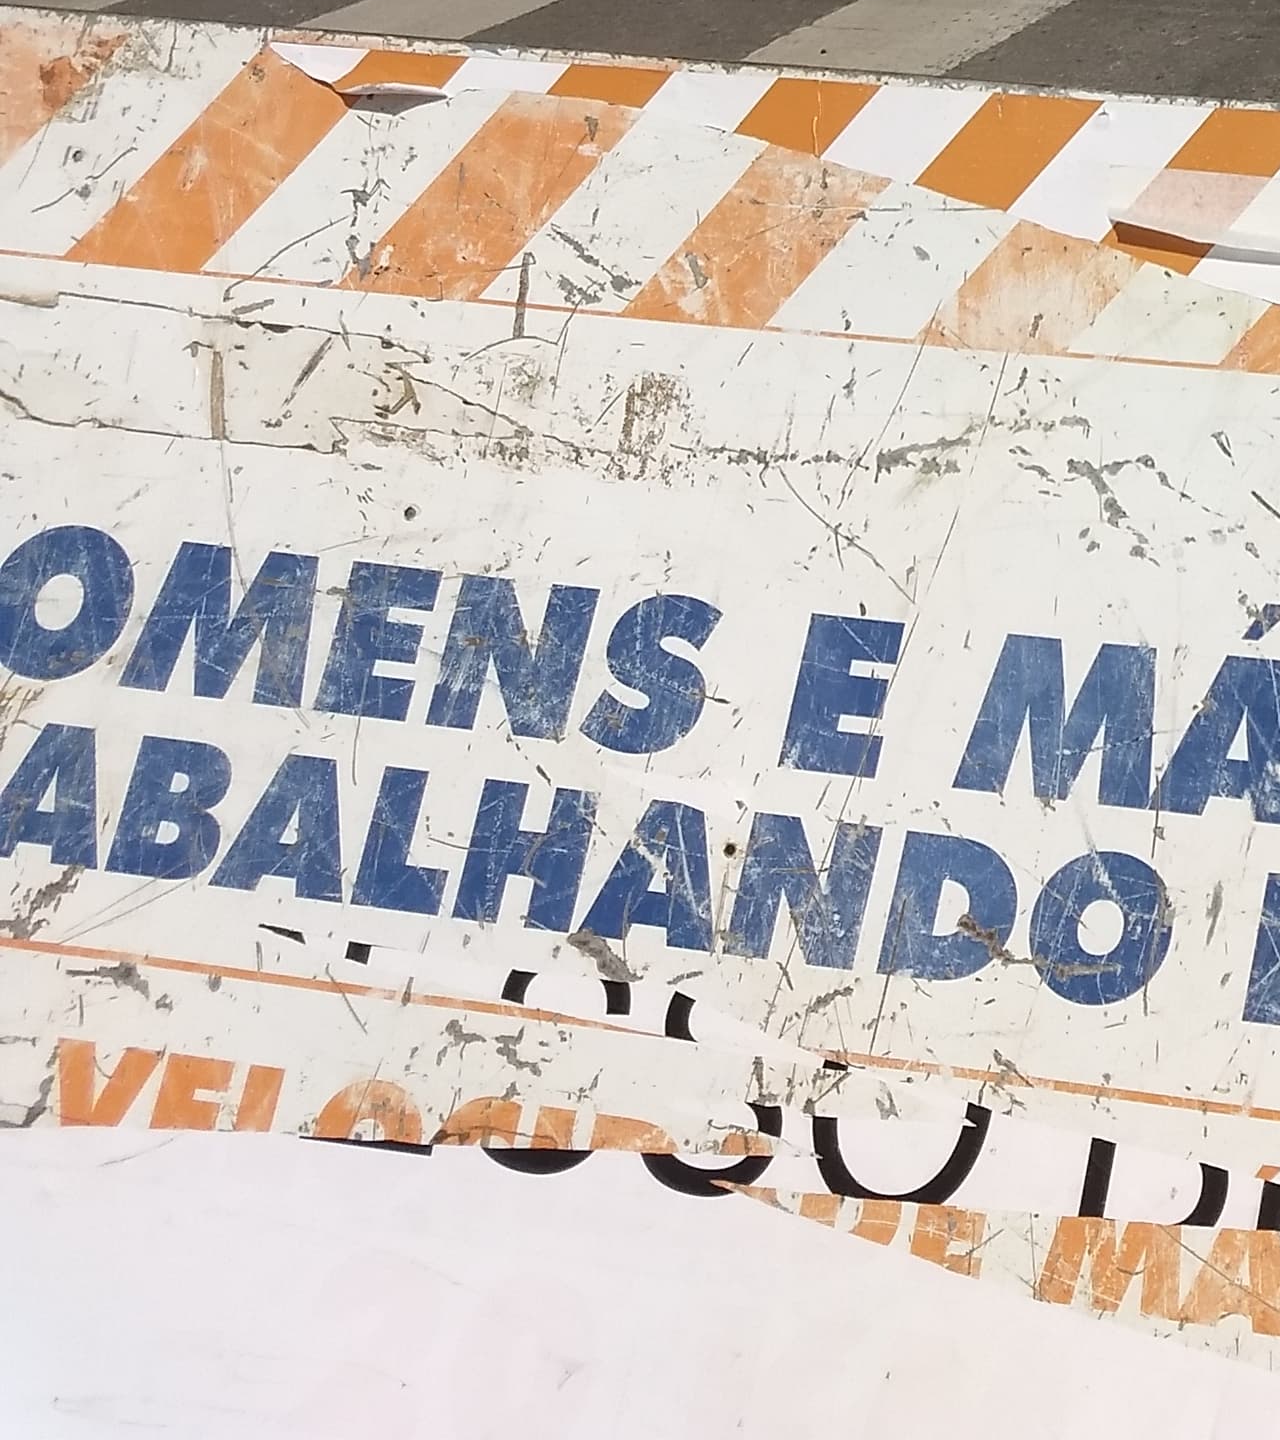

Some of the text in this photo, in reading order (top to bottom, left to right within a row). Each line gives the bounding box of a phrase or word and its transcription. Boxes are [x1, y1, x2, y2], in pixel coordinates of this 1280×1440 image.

[0, 525, 720, 756] OMENS
[778, 613, 905, 778] E
[0, 723, 1171, 1006] ABALHANDO
